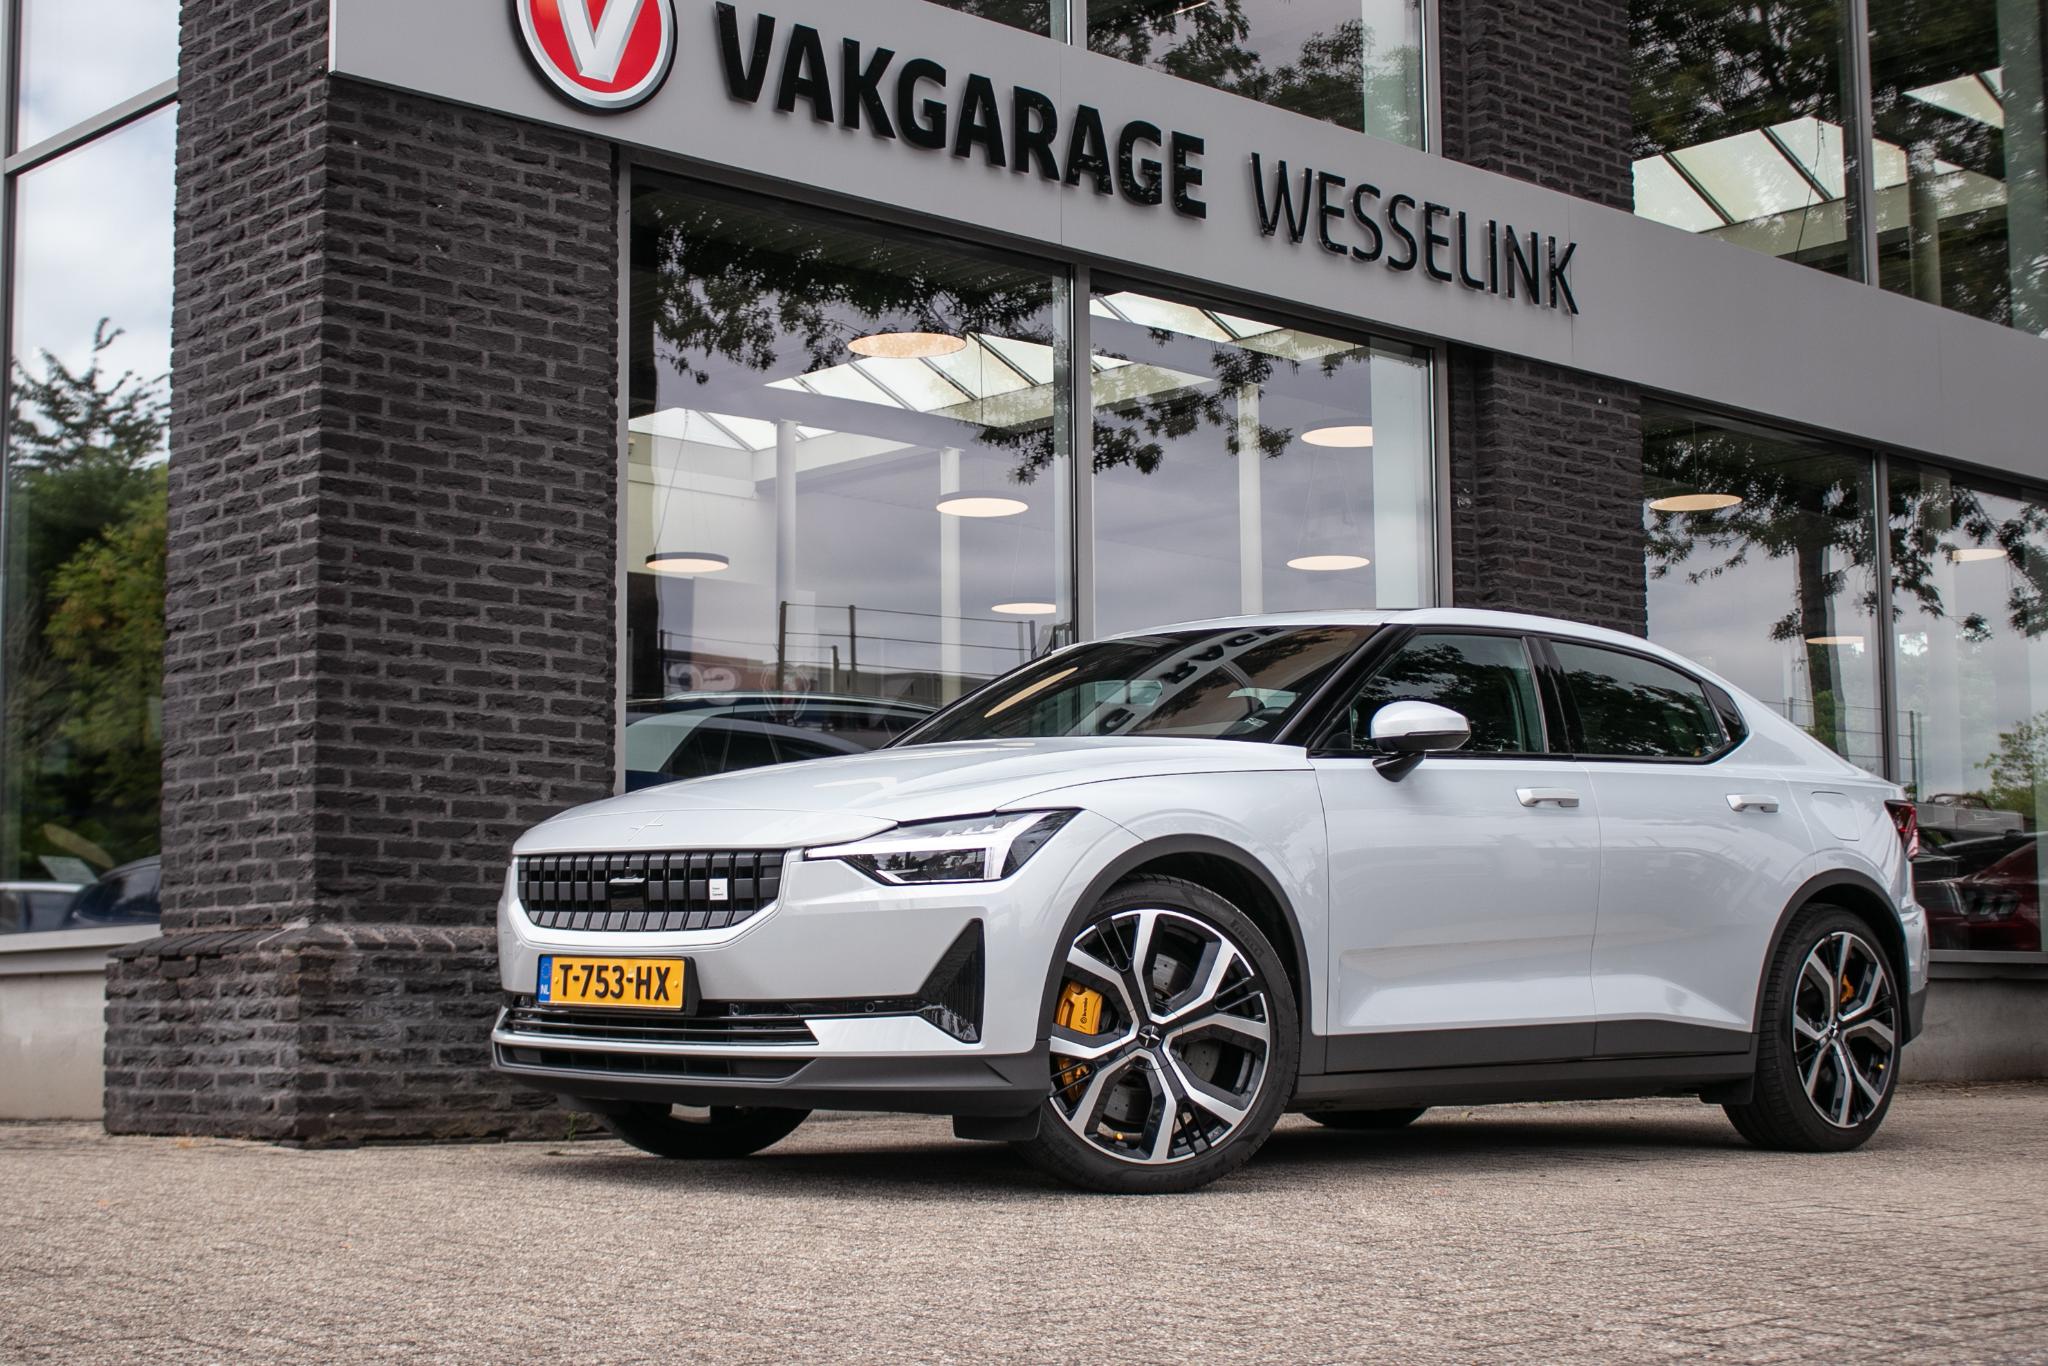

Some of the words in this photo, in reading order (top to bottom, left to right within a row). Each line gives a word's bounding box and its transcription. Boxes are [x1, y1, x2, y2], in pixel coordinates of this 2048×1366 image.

[715, 1, 1207, 220] VAKGARAGE
[1250, 152, 1579, 315] WESSELINK
[540, 984, 550, 995] NL
[559, 964, 671, 1001] T-753-HX
